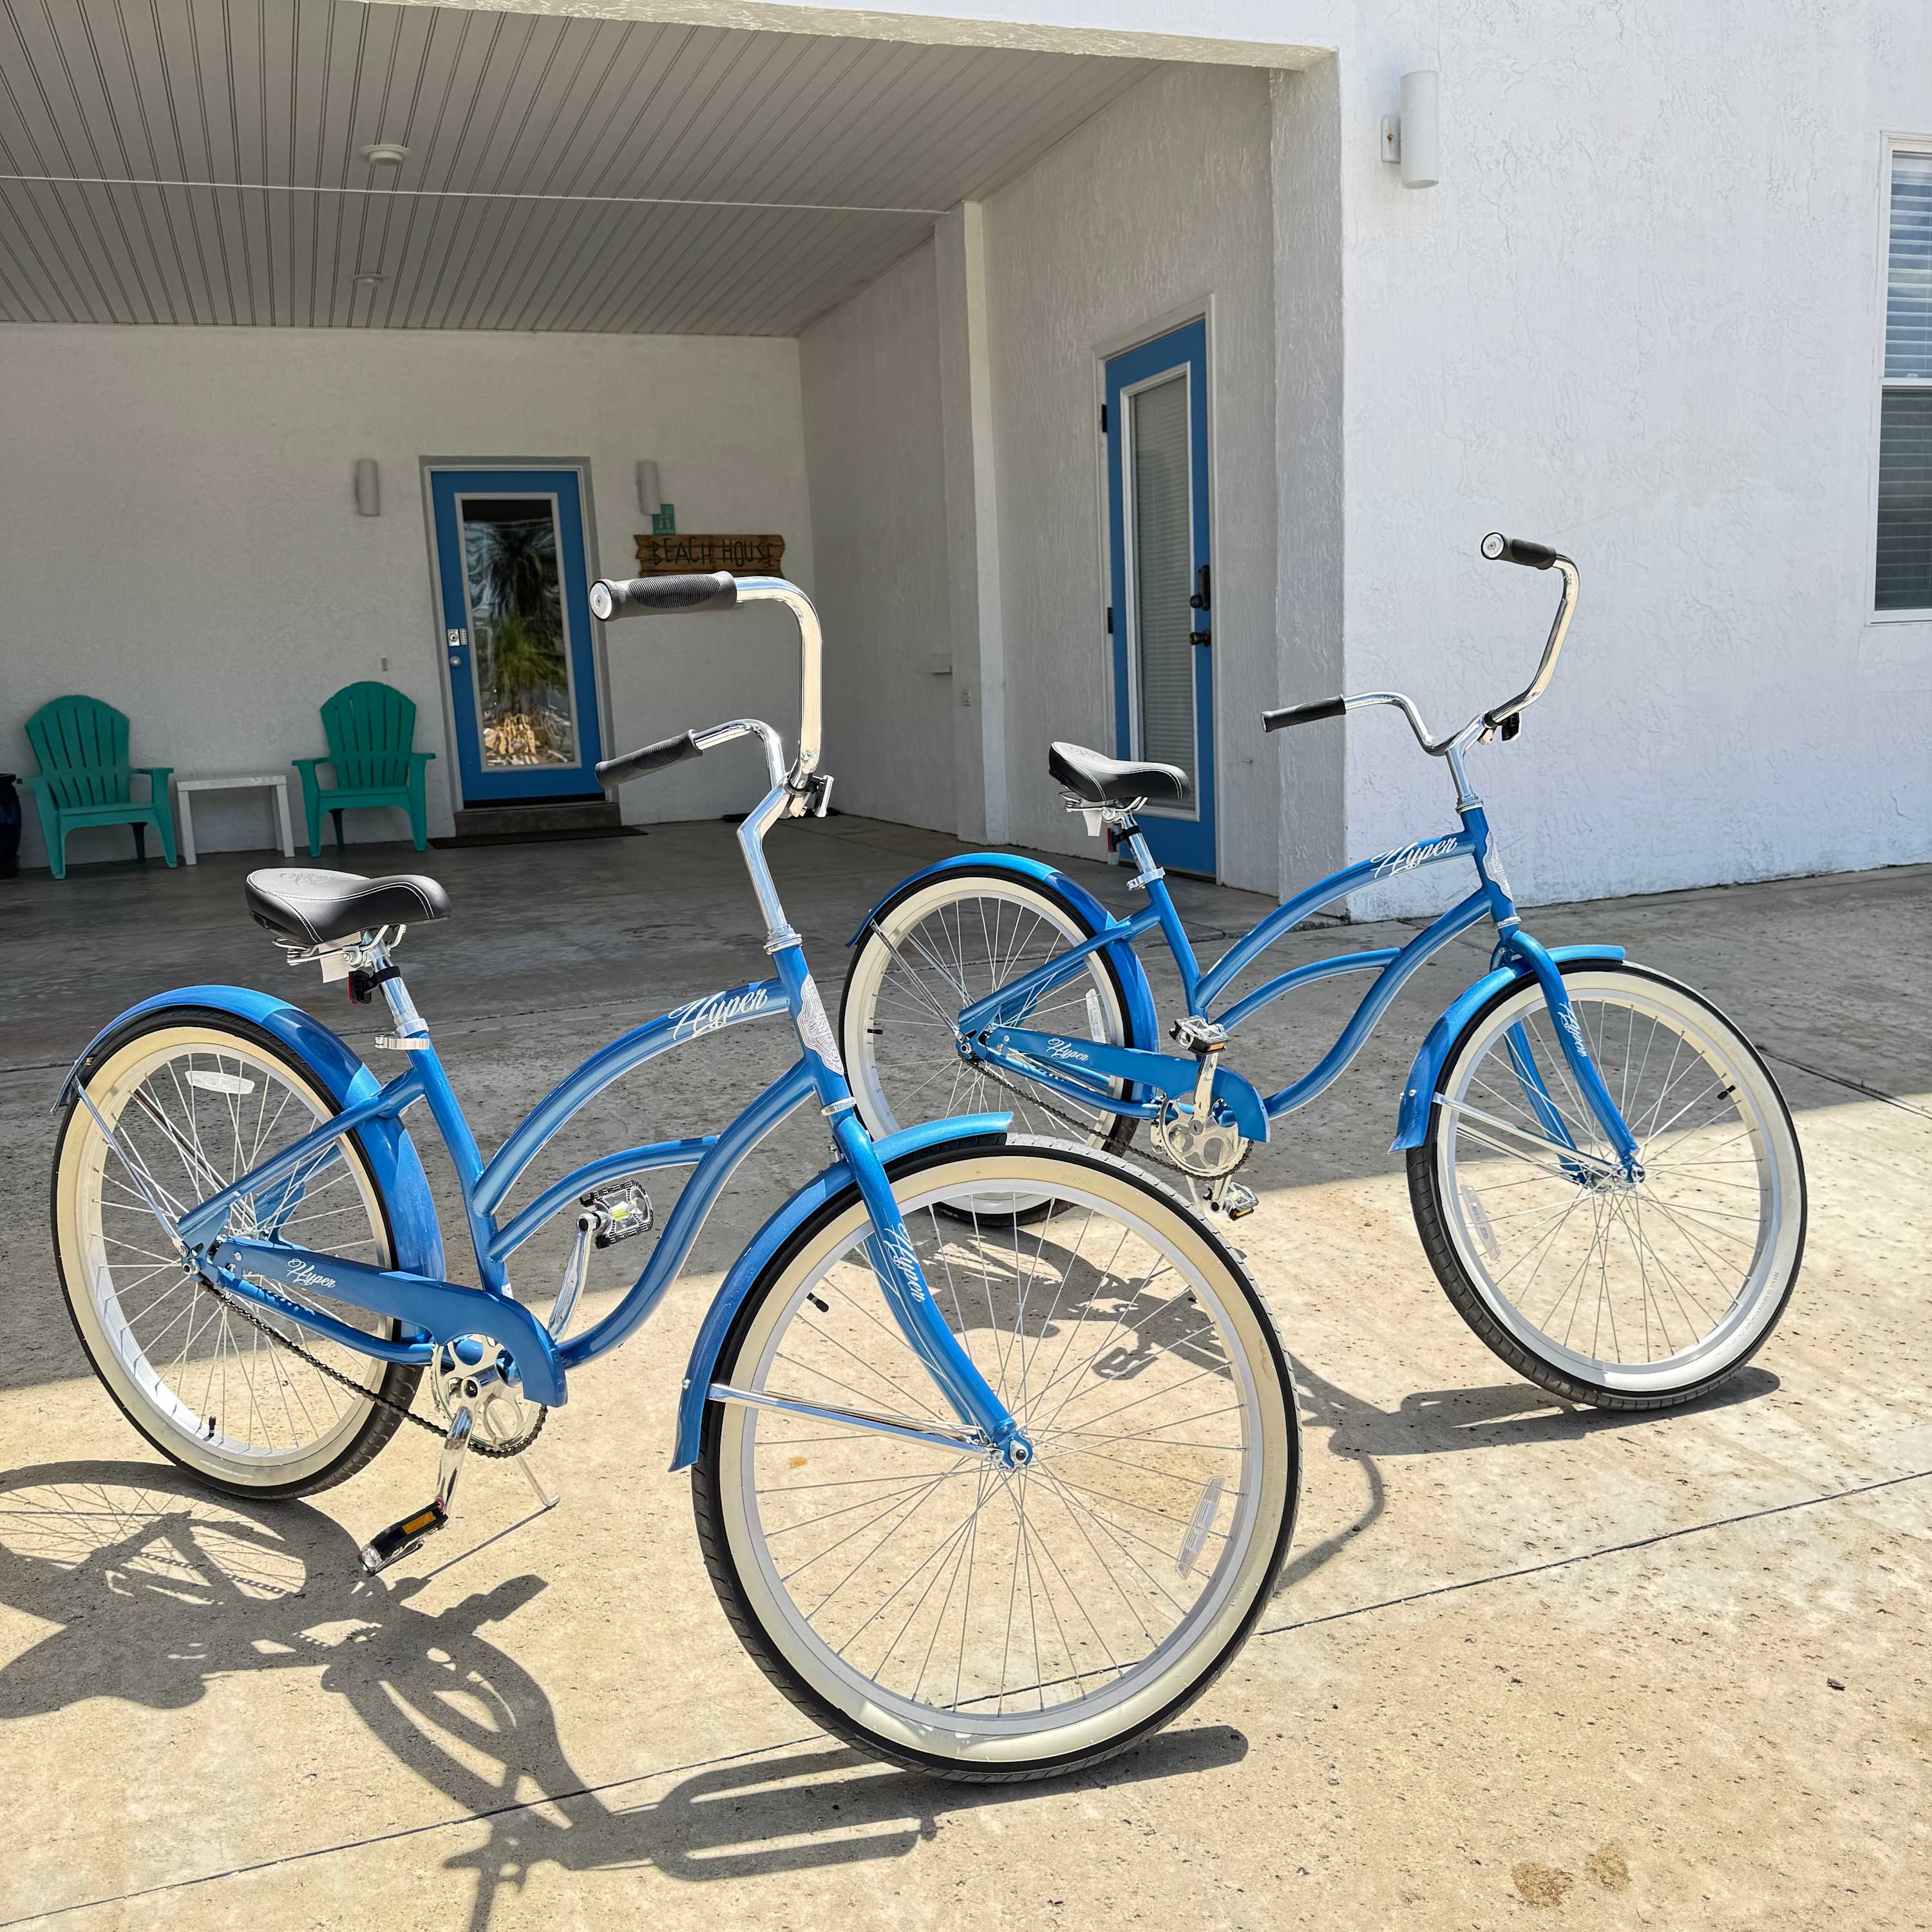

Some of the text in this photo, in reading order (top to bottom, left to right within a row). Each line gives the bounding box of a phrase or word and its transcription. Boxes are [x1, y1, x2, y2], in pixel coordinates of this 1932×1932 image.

[651, 537, 775, 567] BEACH HOUSE
[1370, 837, 1458, 878] Hyper
[667, 988, 768, 1041] Hyper
[1046, 1037, 1089, 1061] Hyper
[287, 1258, 336, 1288] Hyper
[883, 1222, 926, 1303] Hyper
